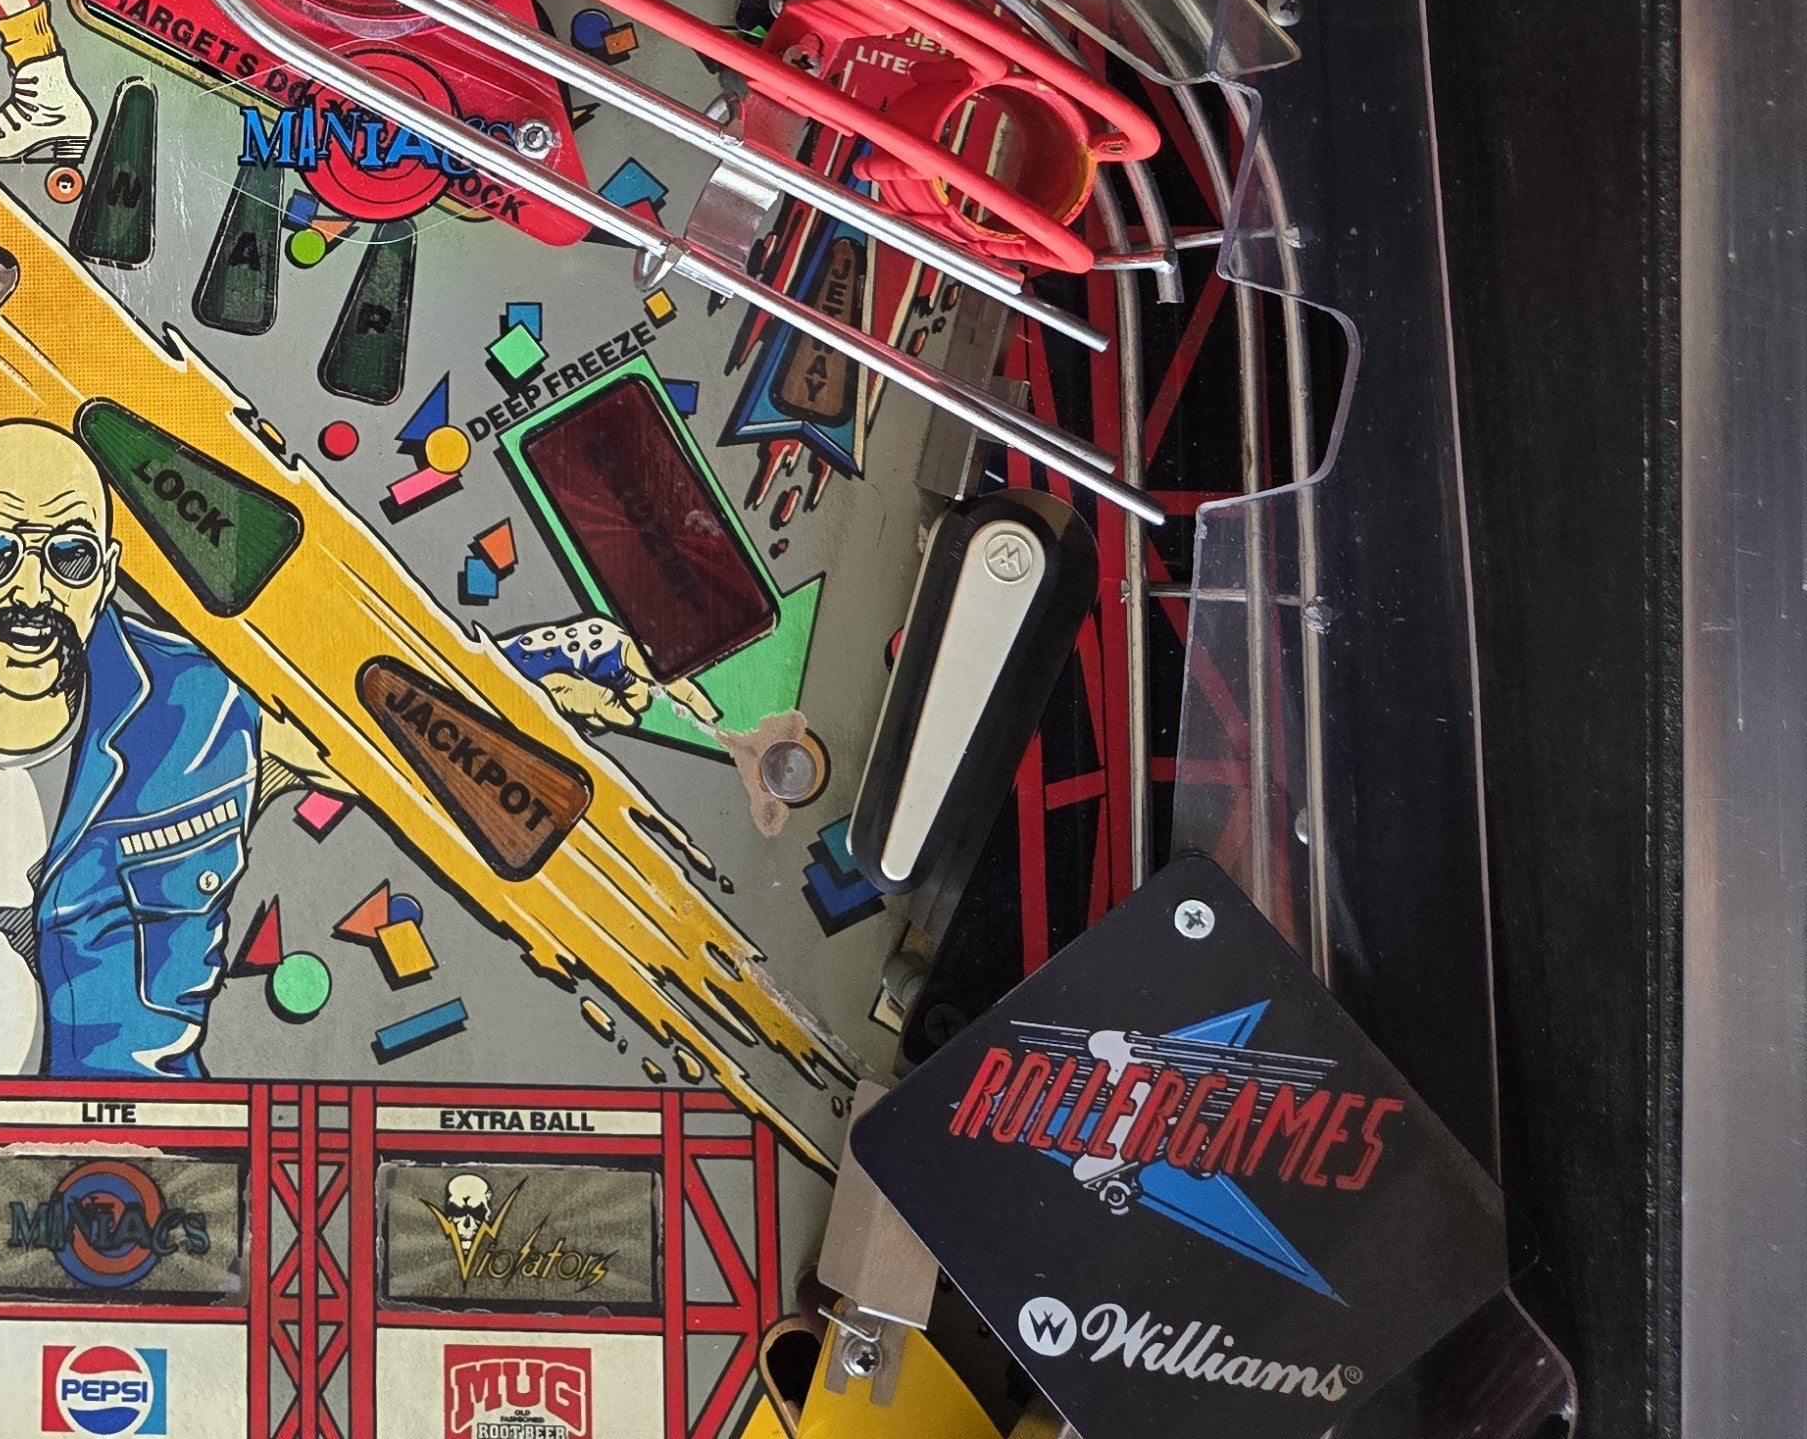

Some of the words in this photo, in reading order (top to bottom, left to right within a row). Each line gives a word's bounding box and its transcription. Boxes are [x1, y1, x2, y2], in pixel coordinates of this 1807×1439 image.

[106, 170, 142, 210] W
[229, 231, 262, 273] A
[465, 383, 542, 443] DEEP
[542, 320, 657, 399] FREEZE
[136, 457, 238, 551] LOCK
[384, 688, 557, 834] JACKPOT
[81, 1102, 137, 1124] LITE
[439, 1108, 526, 1132] EXTRA
[529, 1110, 596, 1133] BALL
[948, 1046, 1406, 1192] ROLLERGAMES
[7, 1198, 212, 1258] MANIACS
[418, 1174, 620, 1295] Violators
[60, 1378, 149, 1403] PEPSI
[451, 1358, 586, 1436] MUG
[477, 1422, 523, 1439] ROOT
[523, 1423, 567, 1439] BEER
